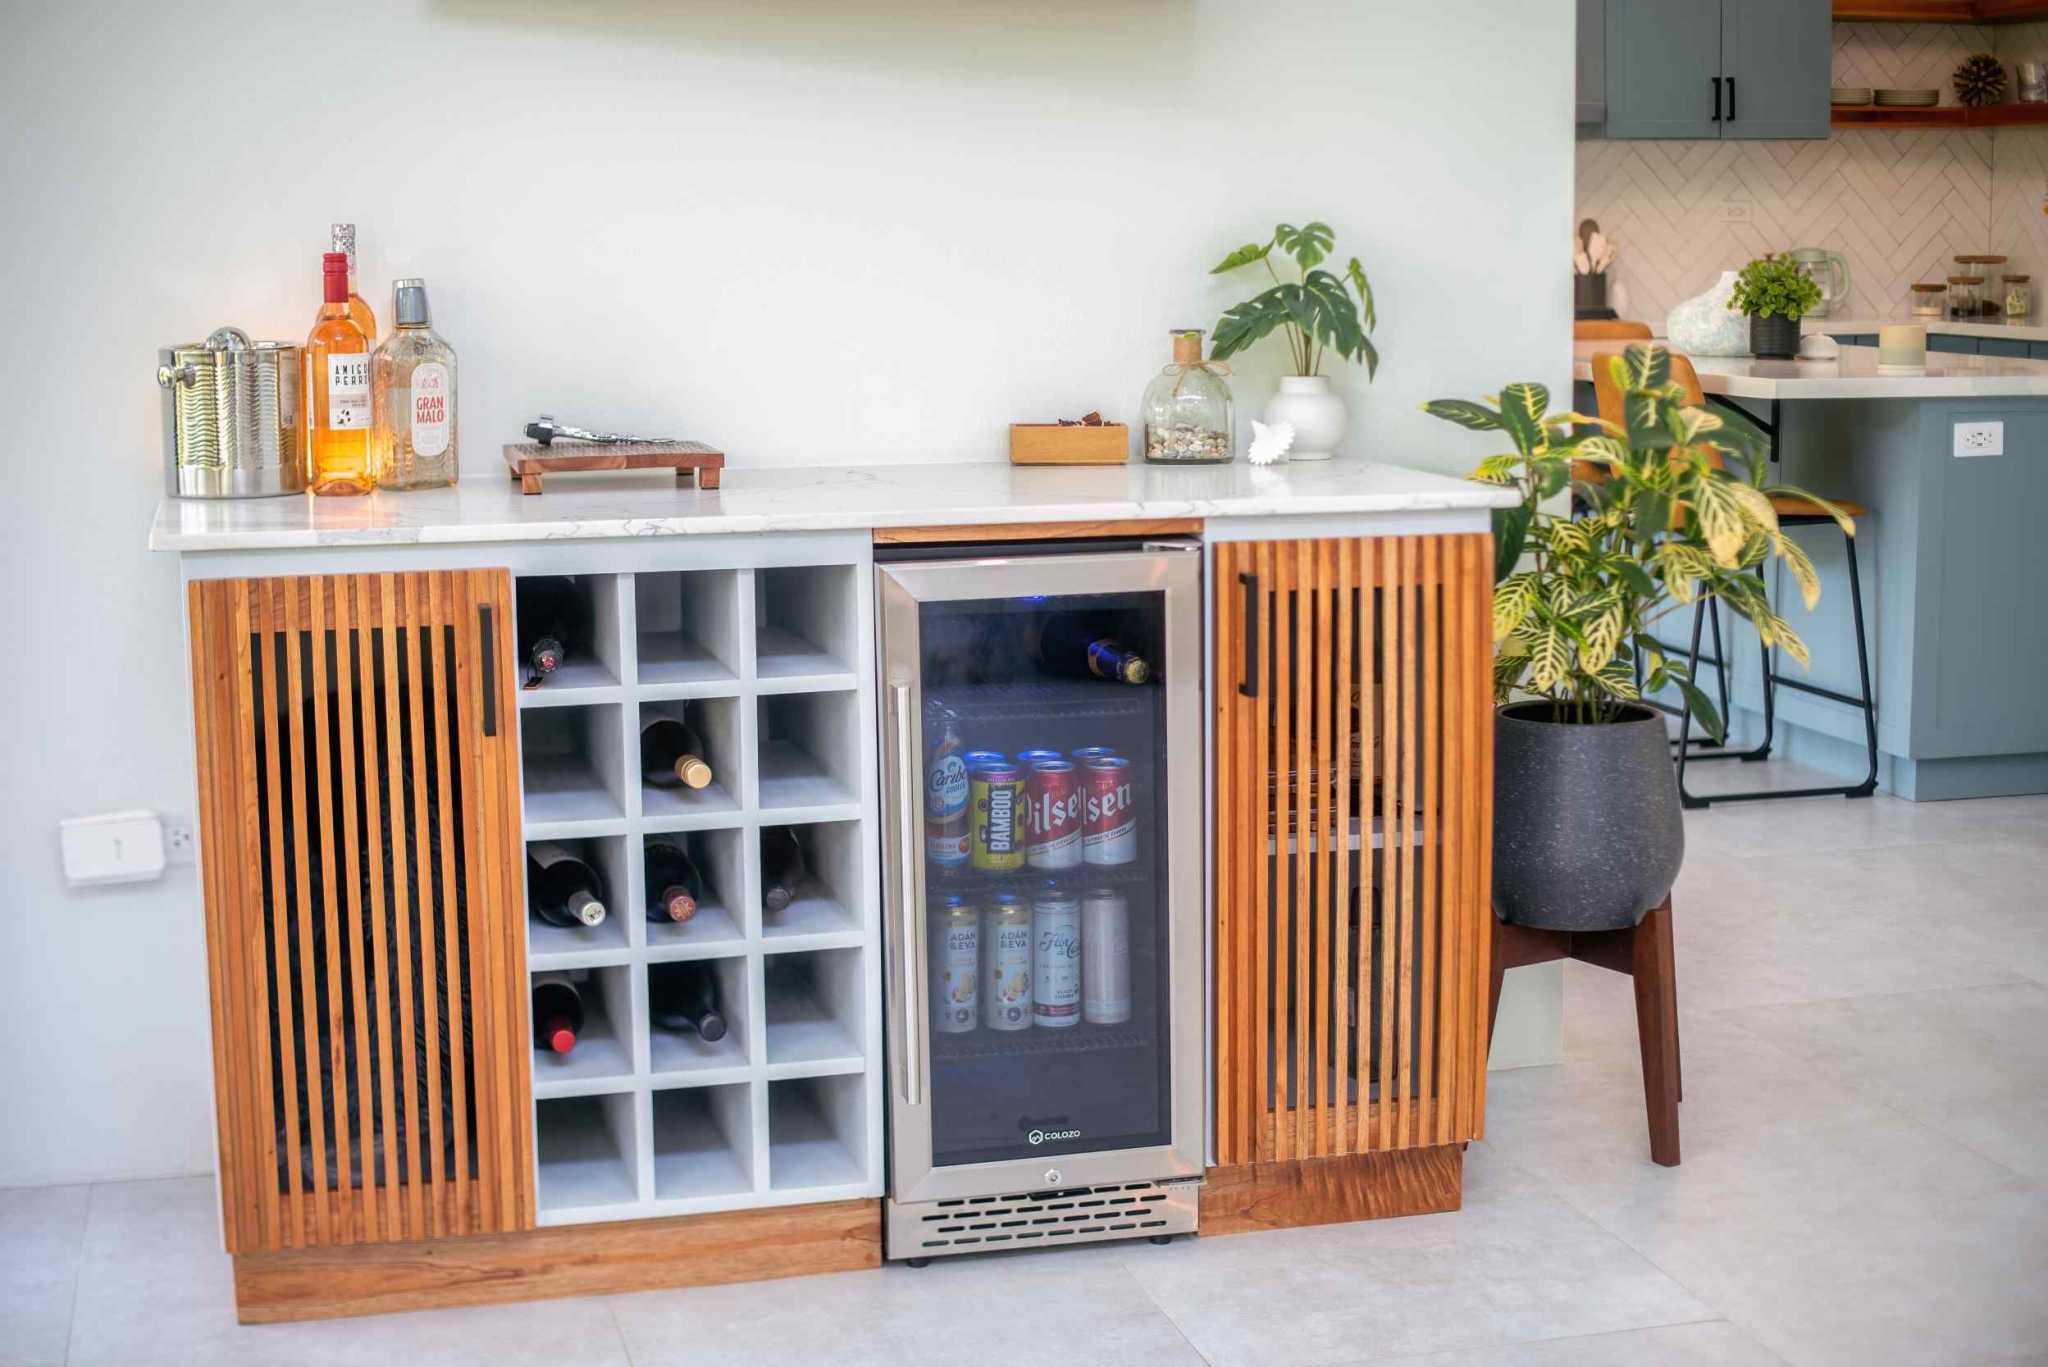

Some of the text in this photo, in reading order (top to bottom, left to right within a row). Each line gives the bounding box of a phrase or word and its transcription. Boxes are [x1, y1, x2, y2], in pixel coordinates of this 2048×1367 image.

[417, 396, 444, 411] GRAN
[416, 410, 445, 425] MALO
[991, 790, 1012, 851] BAMBOO
[1044, 1129, 1081, 1140] COLOZO
